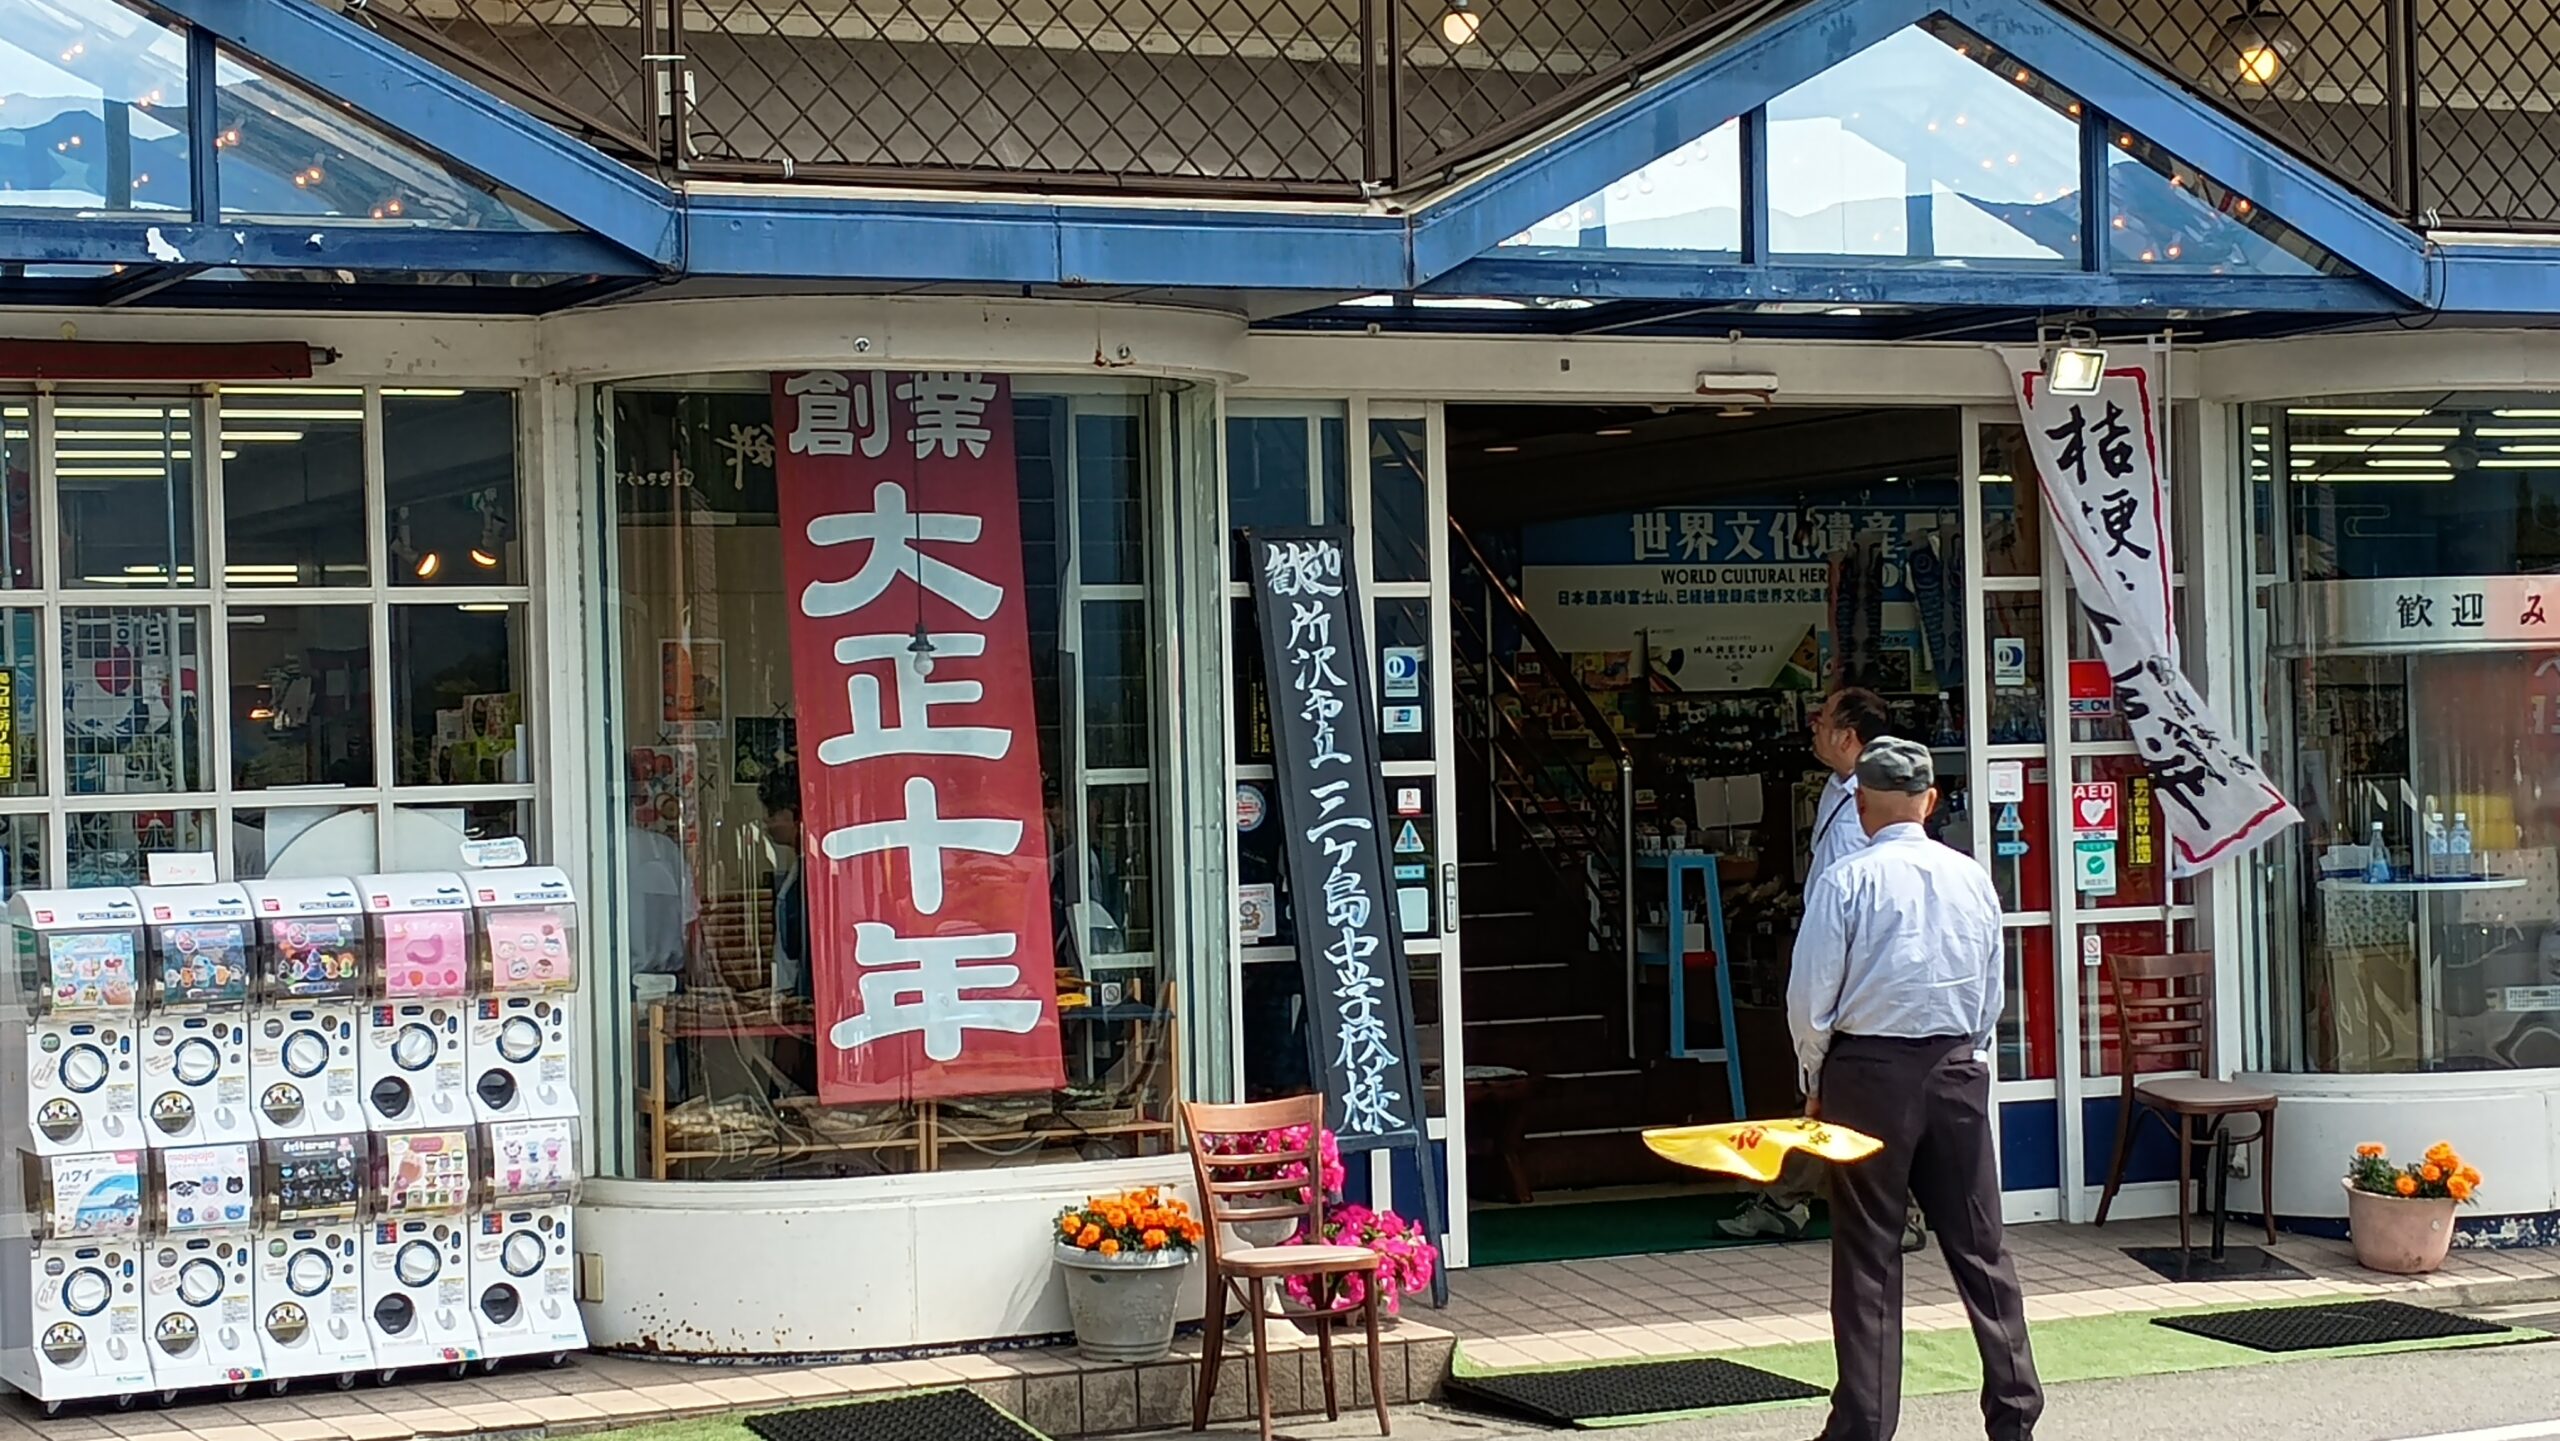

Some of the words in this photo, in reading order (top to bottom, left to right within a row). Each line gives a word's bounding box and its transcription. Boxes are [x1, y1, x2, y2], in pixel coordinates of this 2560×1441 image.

[784, 372, 998, 459] 創業
[1661, 569, 1717, 586] WORLD
[1721, 568, 1796, 585] CULTURAL
[2396, 593, 2485, 629] 歓迎
[2520, 595, 2546, 626] み
[801, 480, 1043, 1062] 大正十年
[2073, 785, 2113, 799] AED
[57, 1168, 93, 1184] ハワイ
